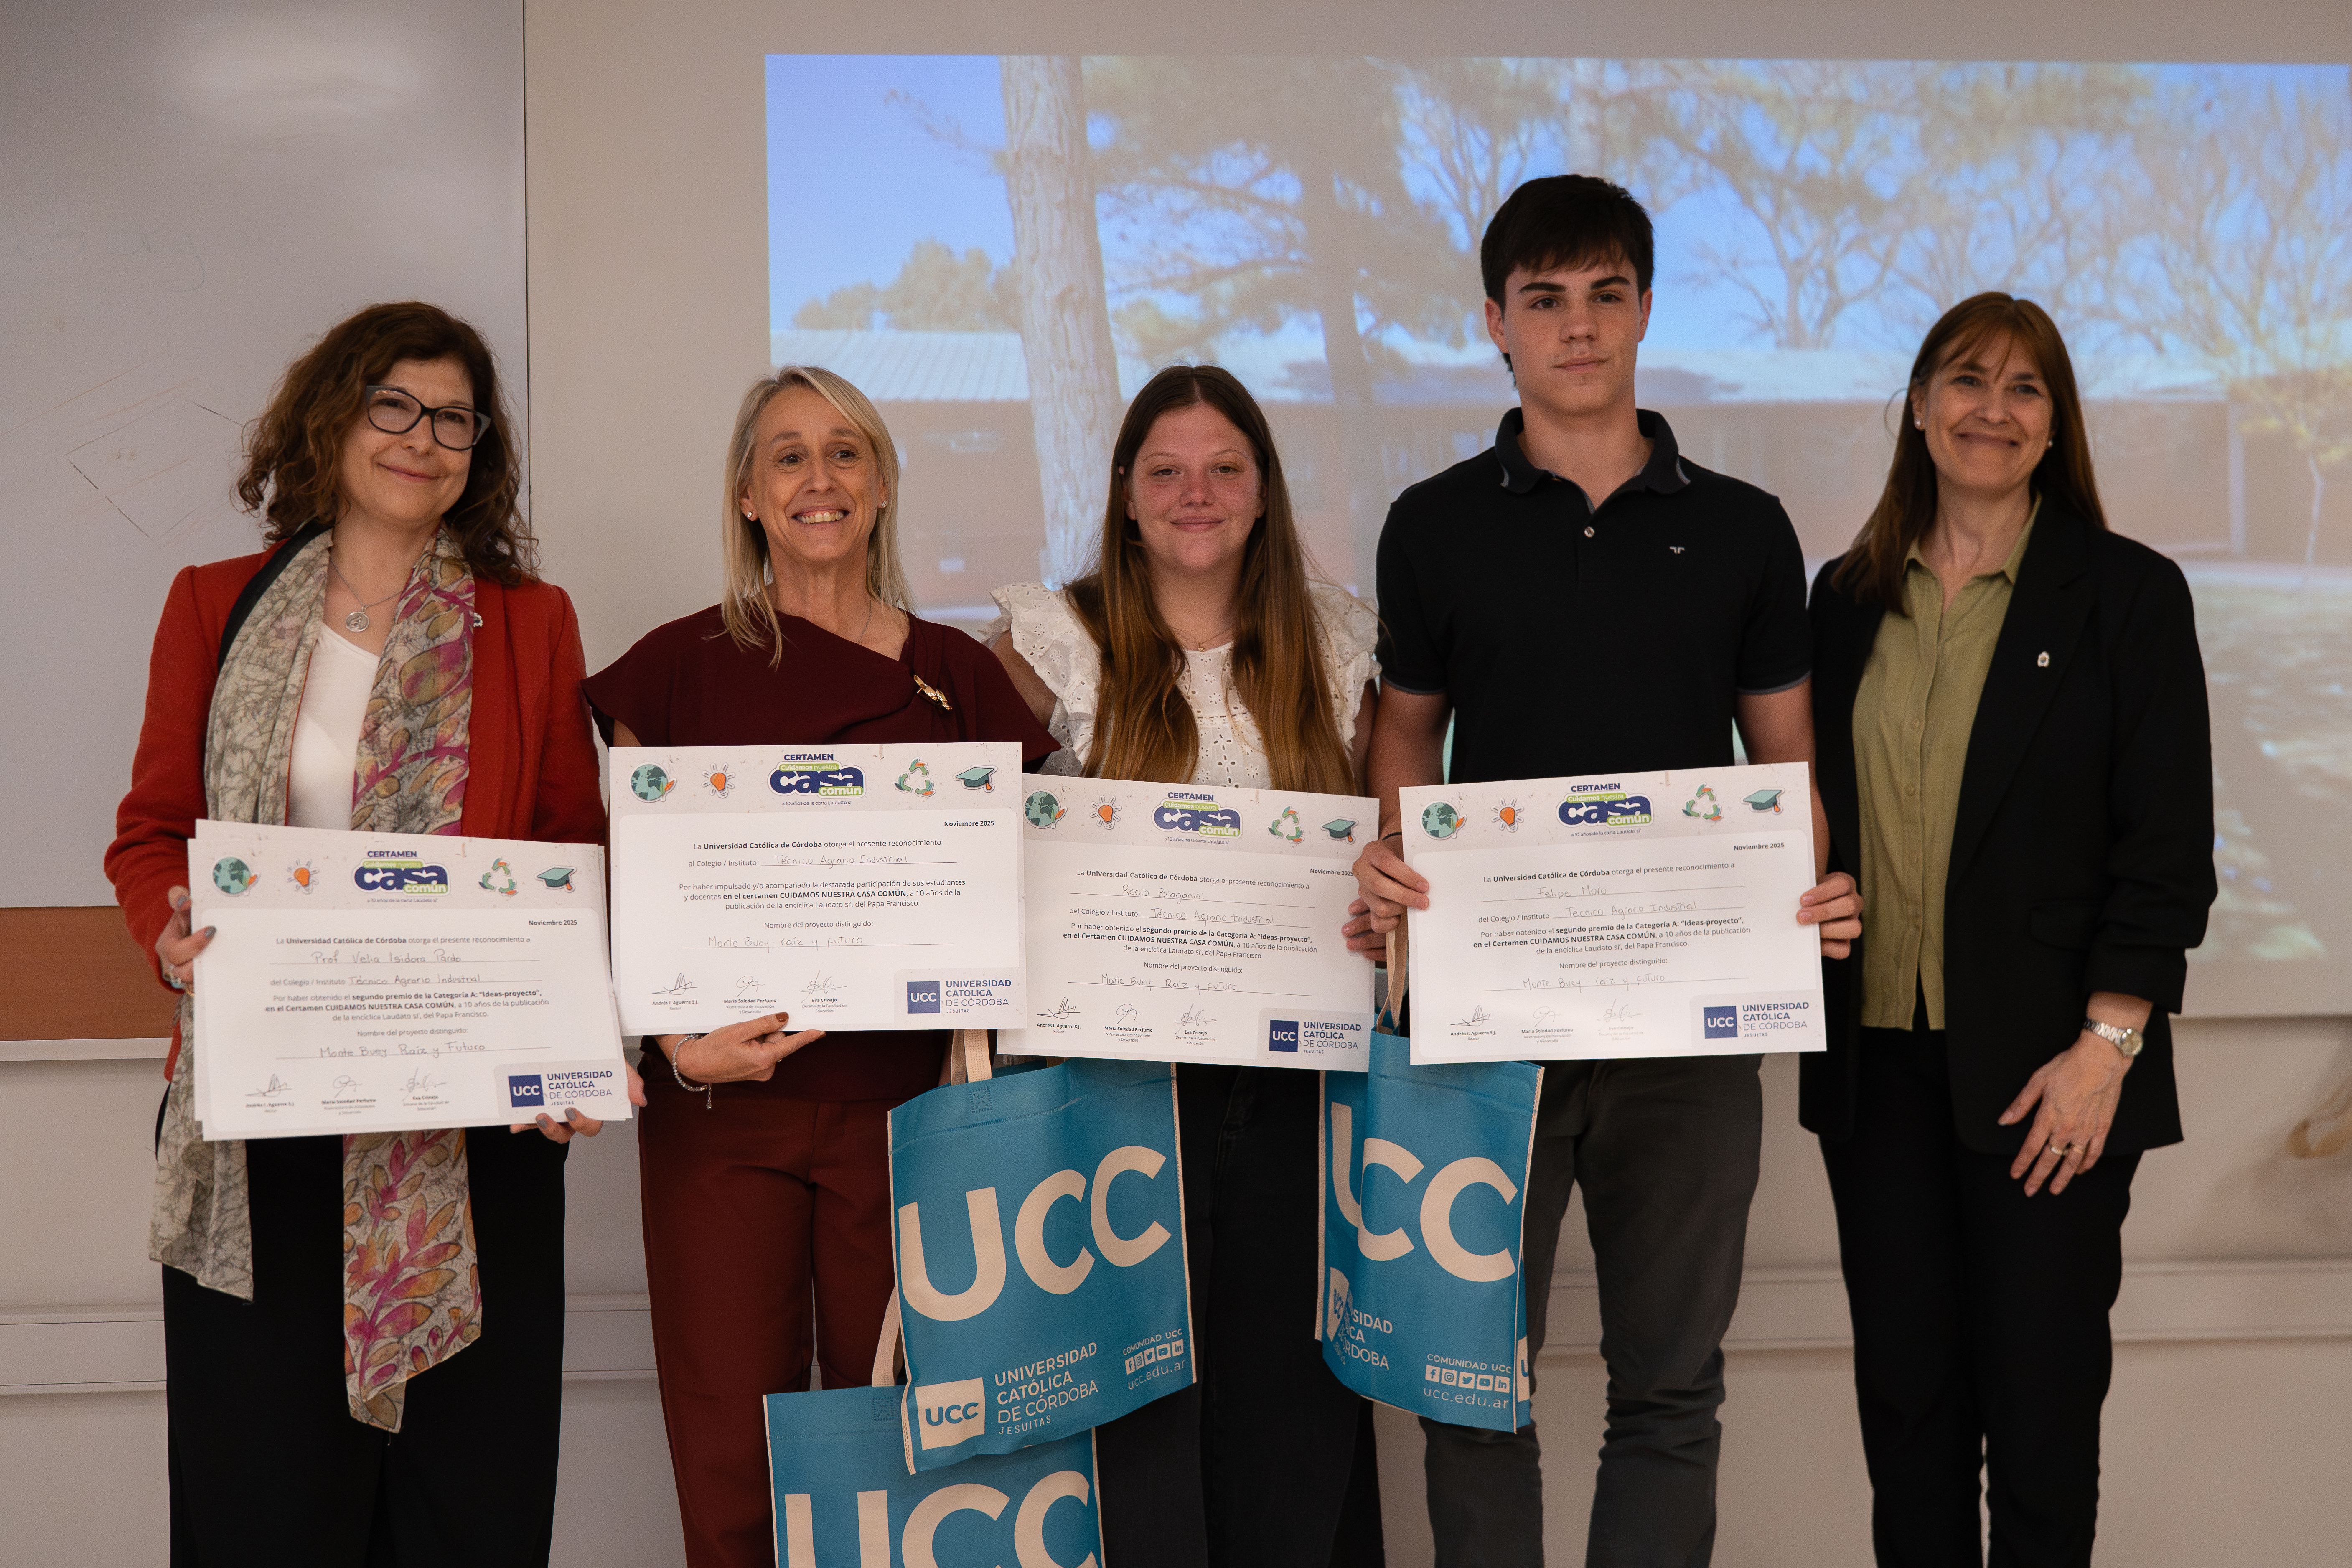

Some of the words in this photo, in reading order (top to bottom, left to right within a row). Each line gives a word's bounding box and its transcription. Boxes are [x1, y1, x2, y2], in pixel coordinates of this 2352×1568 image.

[770, 767, 863, 794] casa
[820, 783, 862, 795] común
[1571, 783, 1620, 793] CERTAMEN
[1167, 792, 1214, 801] CERTAMEN
[1559, 796, 1651, 825] casa
[1154, 806, 1241, 831] casa
[1609, 811, 1650, 825] común
[1200, 823, 1238, 836] común
[696, 860, 722, 869] Colegio
[773, 854, 814, 864] Técnico
[820, 855, 854, 869] Agrario
[859, 853, 908, 863] Industrial
[715, 883, 751, 891] impulsado
[856, 880, 901, 889] participación
[1122, 884, 1149, 896] Rocío
[877, 889, 908, 897] COMÚN,
[1536, 887, 1572, 899] Felipe
[725, 902, 765, 911] publicación
[867, 900, 885, 909] Papa
[1151, 907, 1186, 920] Técnico
[1194, 910, 1227, 927] Agrario
[1231, 914, 1274, 924] Industrial
[835, 920, 873, 929] distinguido:
[709, 936, 738, 947] Monte
[811, 939, 818, 951] y
[946, 979, 1012, 988] UNIVERSIDAD
[1102, 973, 1125, 985] Monte
[1194, 983, 1200, 995] y
[911, 993, 936, 1002] UCC
[946, 988, 992, 997] CATÓLICA
[961, 997, 1009, 1006] CÓRDOBA
[1742, 1001, 1810, 1012] UNIVERSIDAD
[1708, 1017, 1734, 1027] UCC
[1742, 1011, 1790, 1022] CATÓLICA
[1304, 1021, 1362, 1032] UNIVERSIDAD
[1743, 1022, 1756, 1031] DE
[1758, 1020, 1808, 1030] CÓRDOBA
[1273, 1031, 1295, 1041] UCC
[1303, 1030, 1345, 1039] CATÓLICA
[1303, 1039, 1315, 1047] DE
[1316, 1039, 1358, 1049] CÓRDOBA
[547, 1070, 613, 1081] UNIVERSIDAD
[513, 1086, 540, 1096] UCC
[548, 1080, 595, 1090] CATÓLICA
[549, 1091, 562, 1100] DE
[564, 1088, 613, 1099] CÓRDOBA
[898, 1146, 1172, 1321] UCC
[1123, 1334, 1162, 1356] COMUNIDAD
[1165, 1328, 1183, 1339] UCC
[994, 1342, 1097, 1386] UNIVERSIDAD
[1427, 1353, 1487, 1370] COMUNIDAD
[1491, 1363, 1512, 1374] UCC
[1128, 1360, 1186, 1390] ucc.edu.ar
[997, 1371, 1073, 1405] CATÓLICA
[998, 1406, 1020, 1423] DE
[1025, 1380, 1098, 1417] CÓRDOBA
[1424, 1387, 1509, 1409] ucc.edu.ar
[925, 1402, 979, 1426] UCC
[999, 1415, 1052, 1434] JESUITAS
[785, 1470, 1096, 1568] UCC
